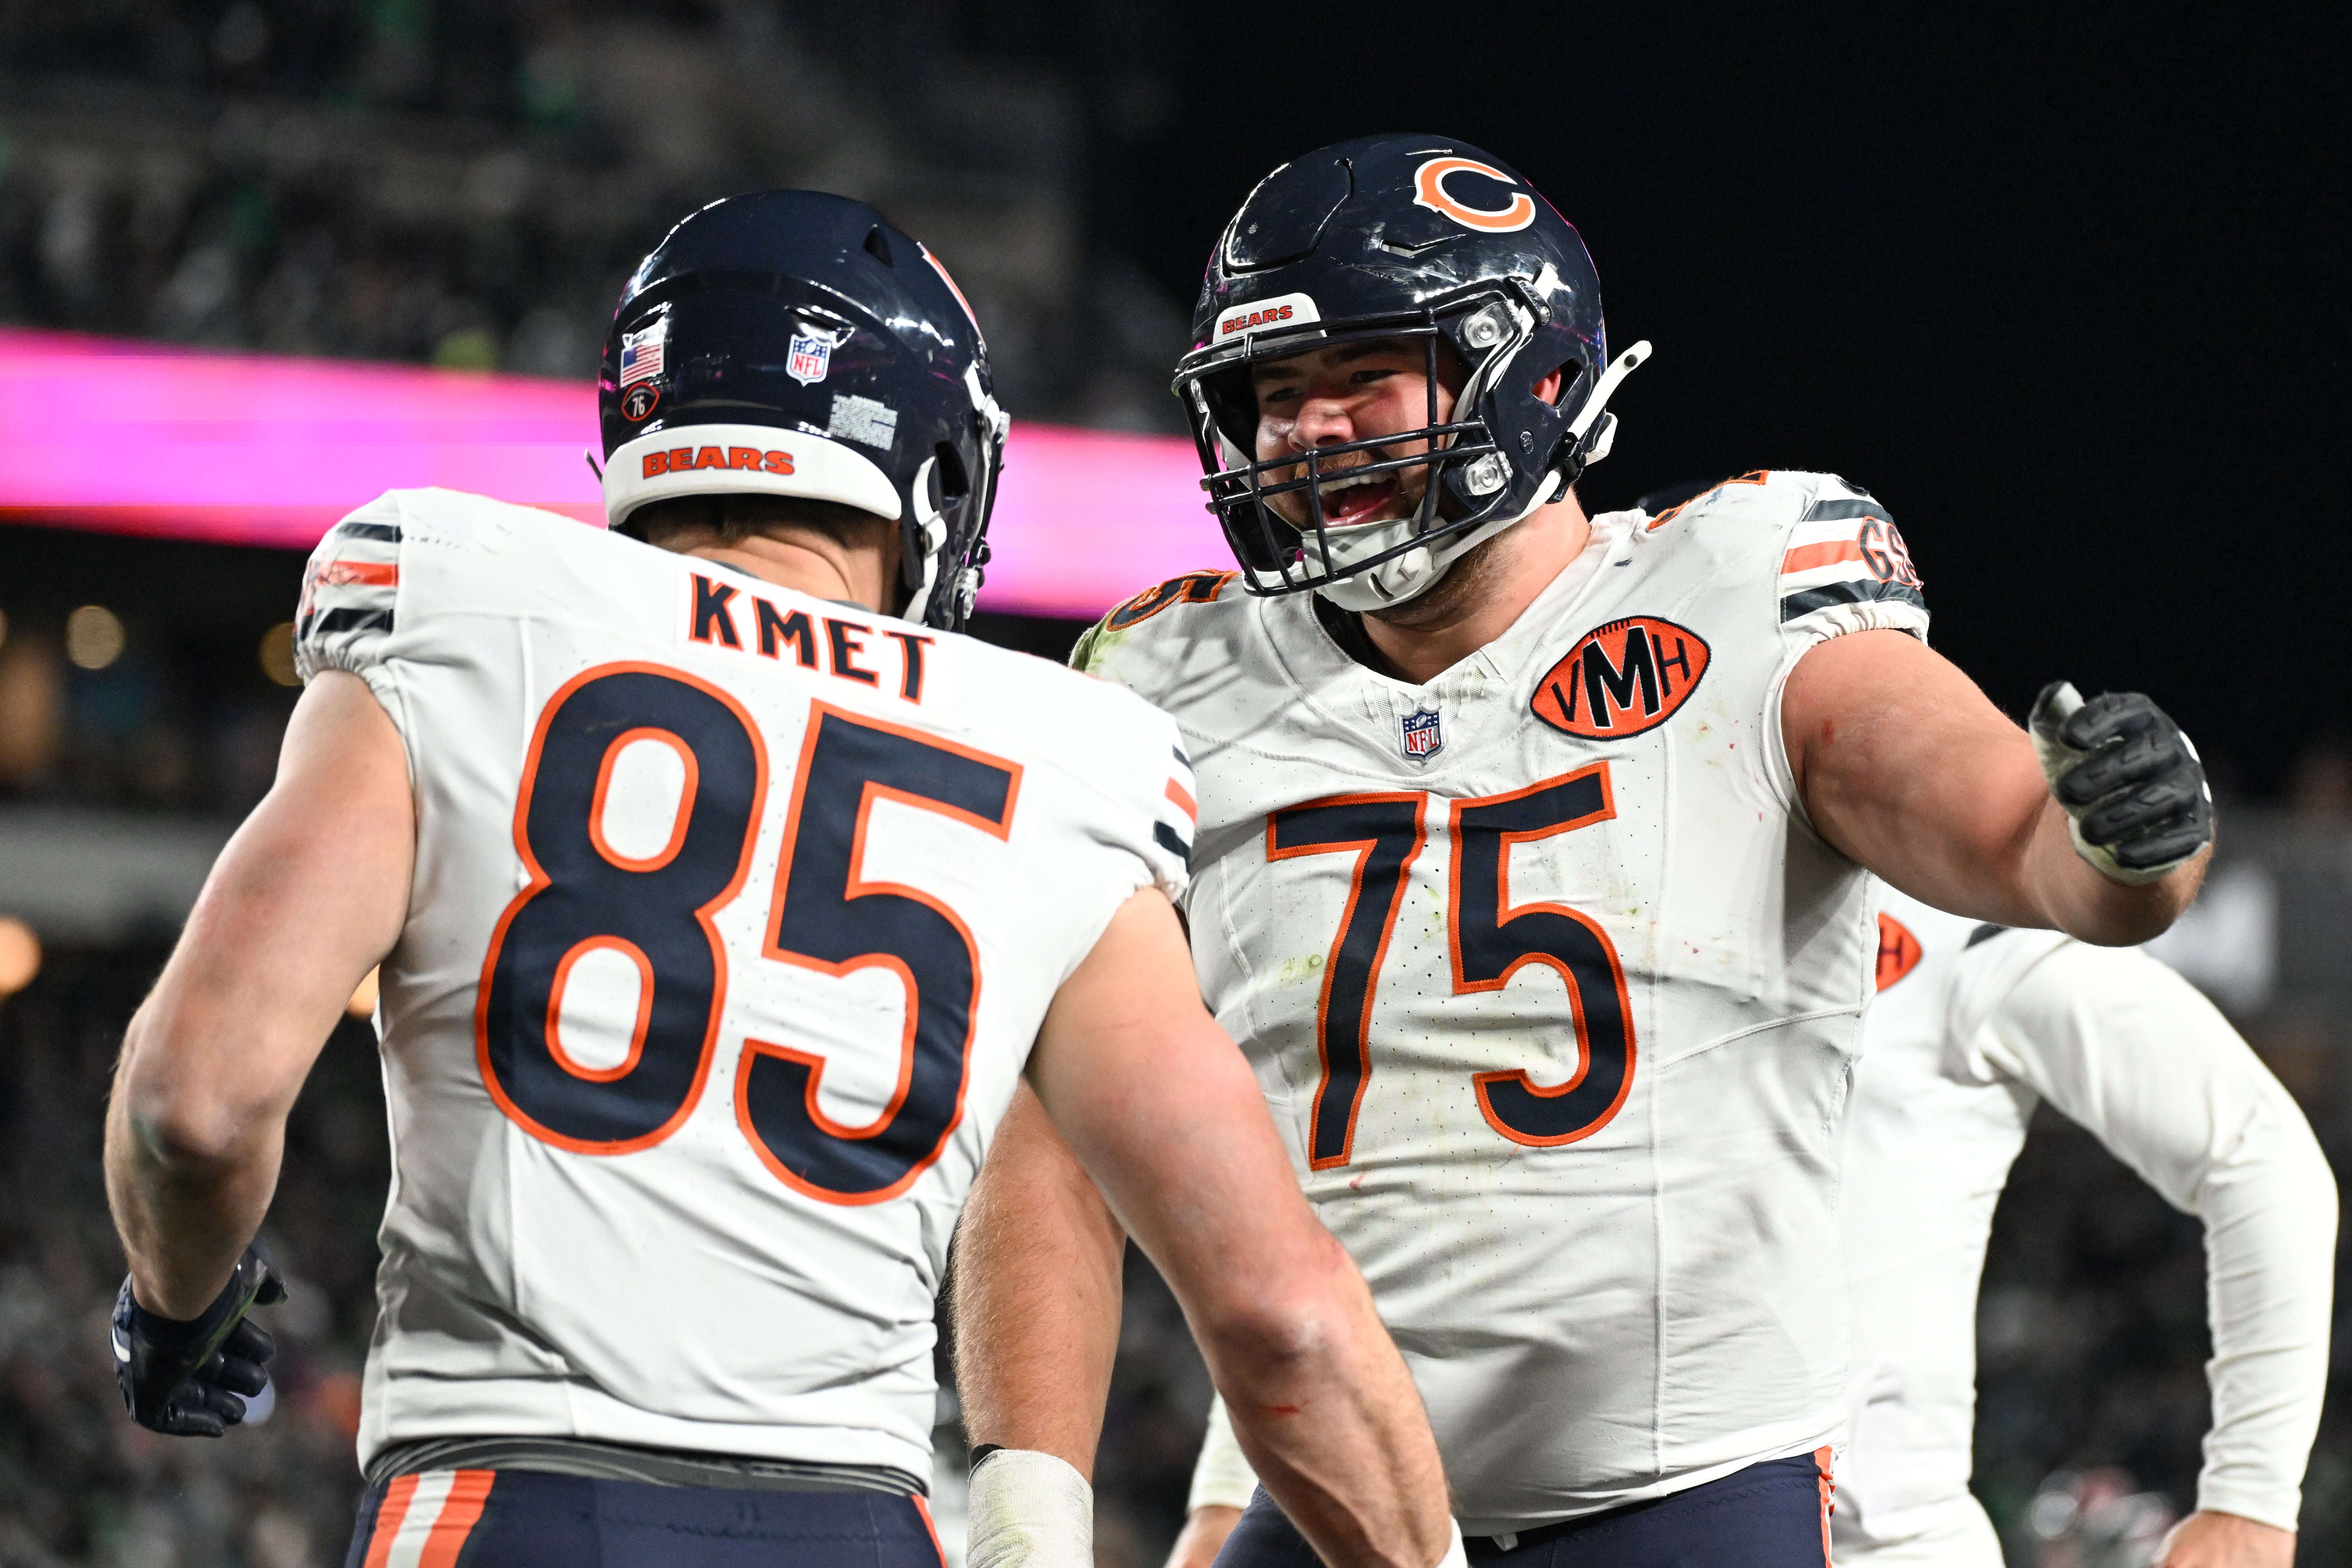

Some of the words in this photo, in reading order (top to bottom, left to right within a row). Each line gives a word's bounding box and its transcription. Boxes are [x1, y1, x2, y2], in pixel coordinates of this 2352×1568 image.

[1222, 305, 1293, 335] BEARS
[792, 354, 822, 375] NFL
[631, 395, 645, 418] 76
[643, 446, 795, 480] BEARS
[1856, 515, 1924, 591] GS
[688, 572, 937, 706] KMET
[1551, 625, 1691, 729] VMH
[1407, 728, 1440, 752] NFL
[475, 660, 1025, 1206] 85
[1267, 760, 1637, 1171] 75
